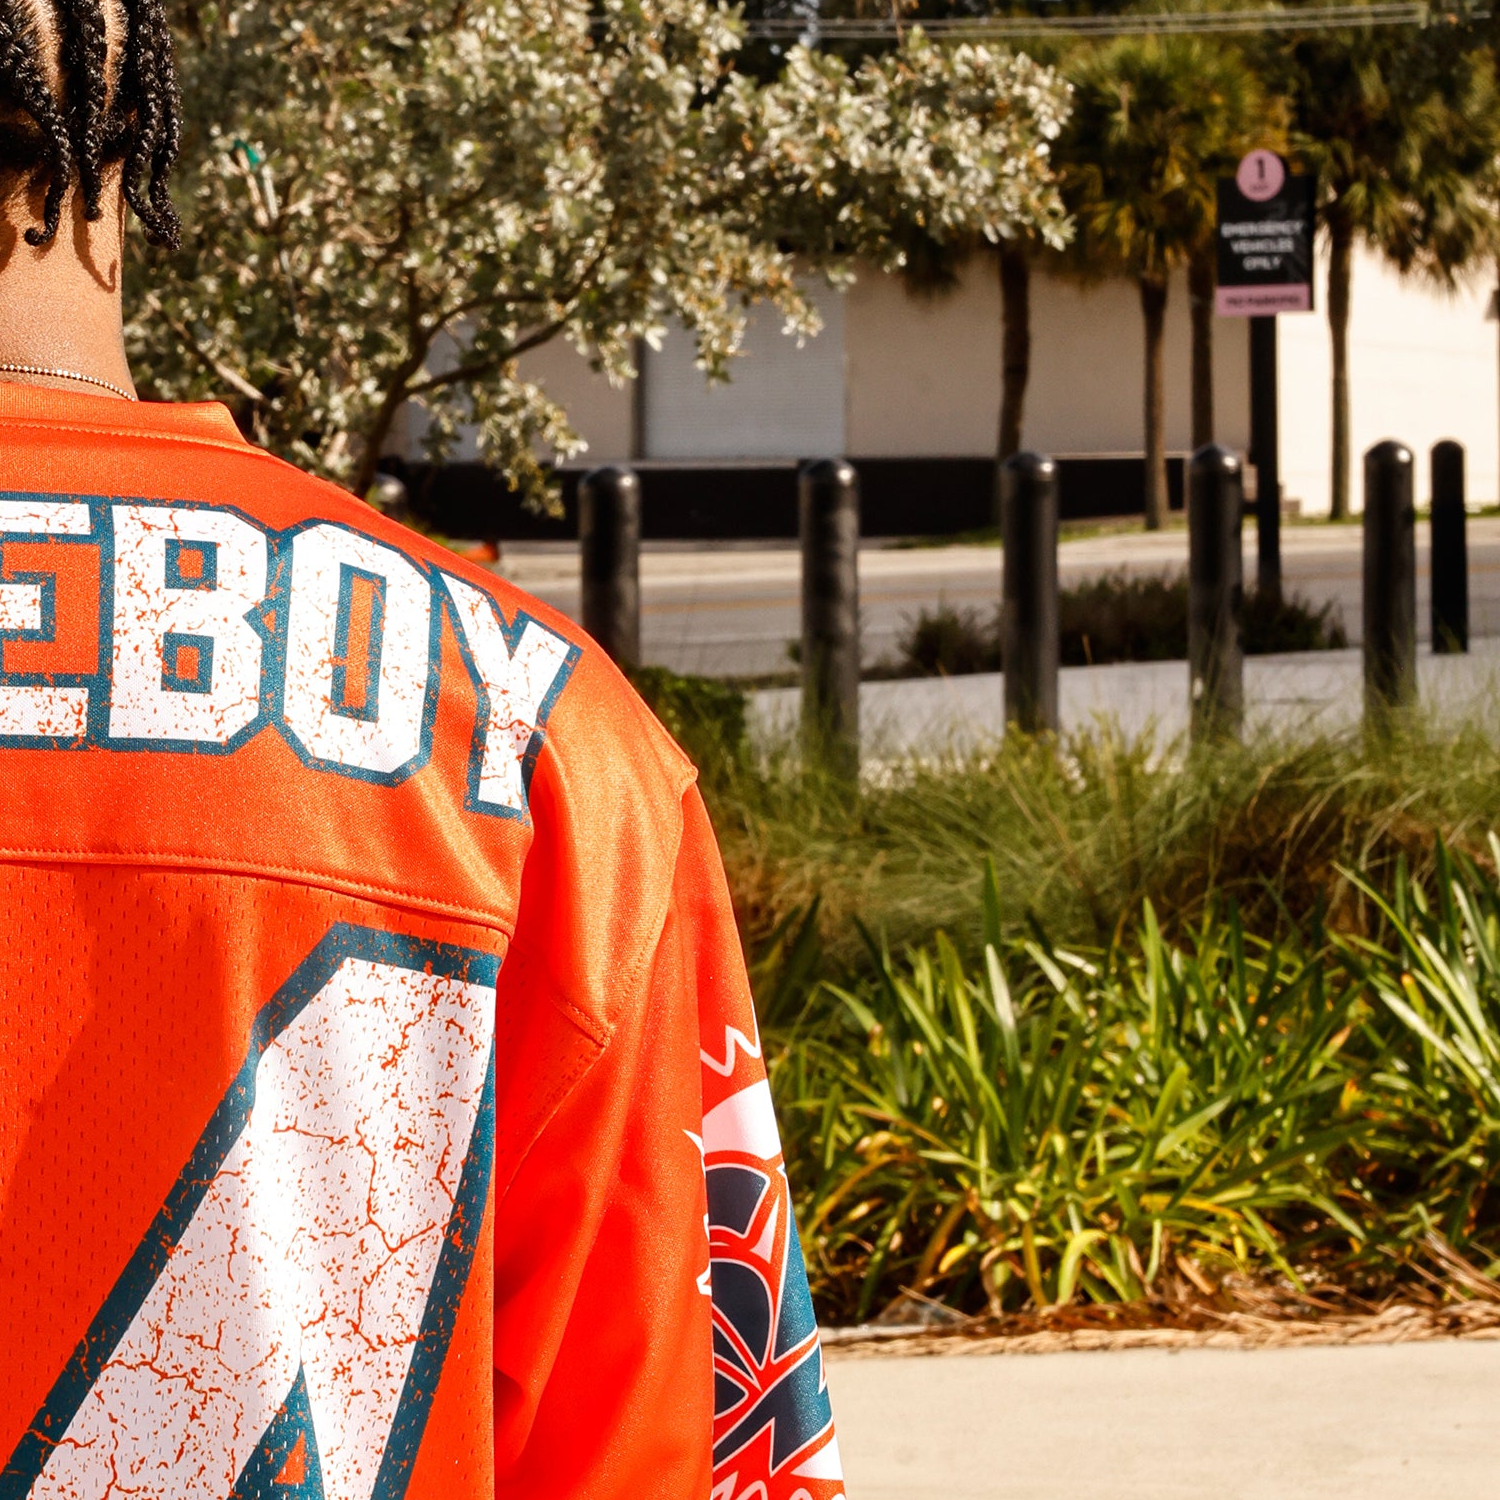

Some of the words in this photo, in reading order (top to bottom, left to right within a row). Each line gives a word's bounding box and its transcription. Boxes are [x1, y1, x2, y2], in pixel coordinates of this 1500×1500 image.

[1221, 220, 1303, 237] EMERGENCY
[1231, 238, 1294, 253] VEHICLES
[1242, 255, 1282, 271] ONLY
